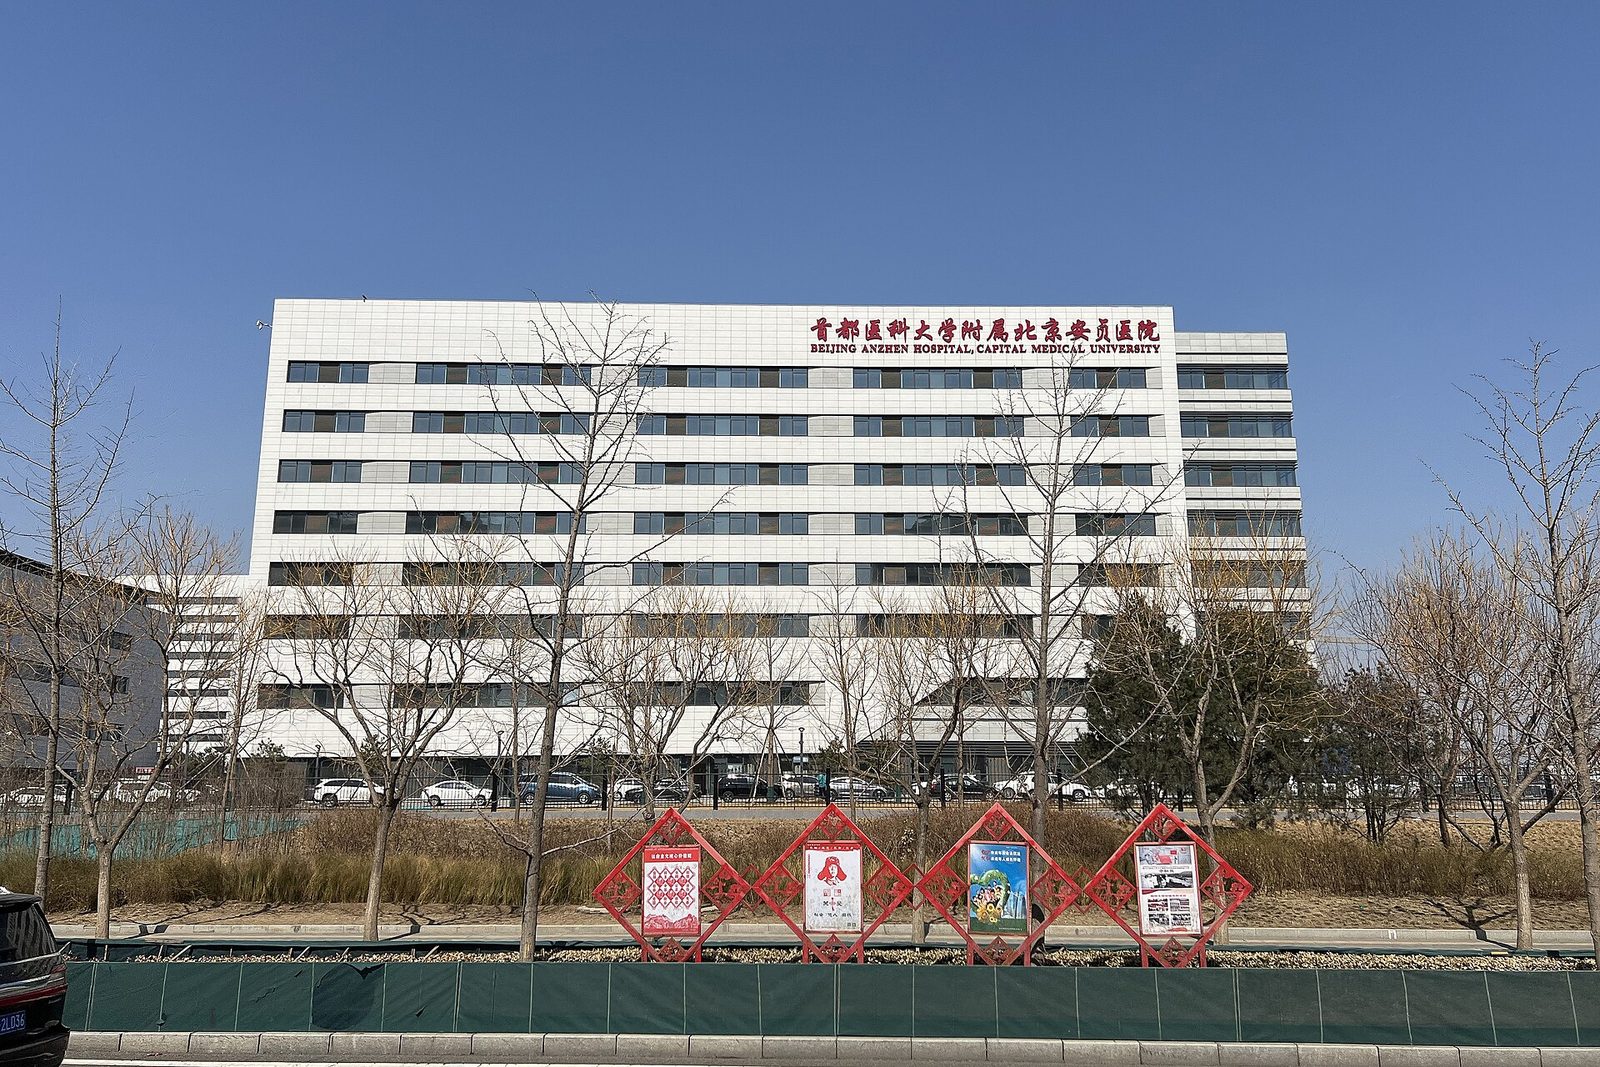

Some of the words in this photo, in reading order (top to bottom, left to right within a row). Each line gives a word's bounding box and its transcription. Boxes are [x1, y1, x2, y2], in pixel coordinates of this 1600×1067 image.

[810, 317, 1161, 343] 首都医科大学附属北京安贞医院
[810, 344, 857, 354] BEIJING
[861, 344, 909, 354] ANZHEN
[912, 344, 975, 356] HOSPITAL,
[976, 344, 1027, 354] CAPITAL
[1030, 344, 1086, 354] MEDICAL
[1089, 344, 1161, 354] UNIVERSITY
